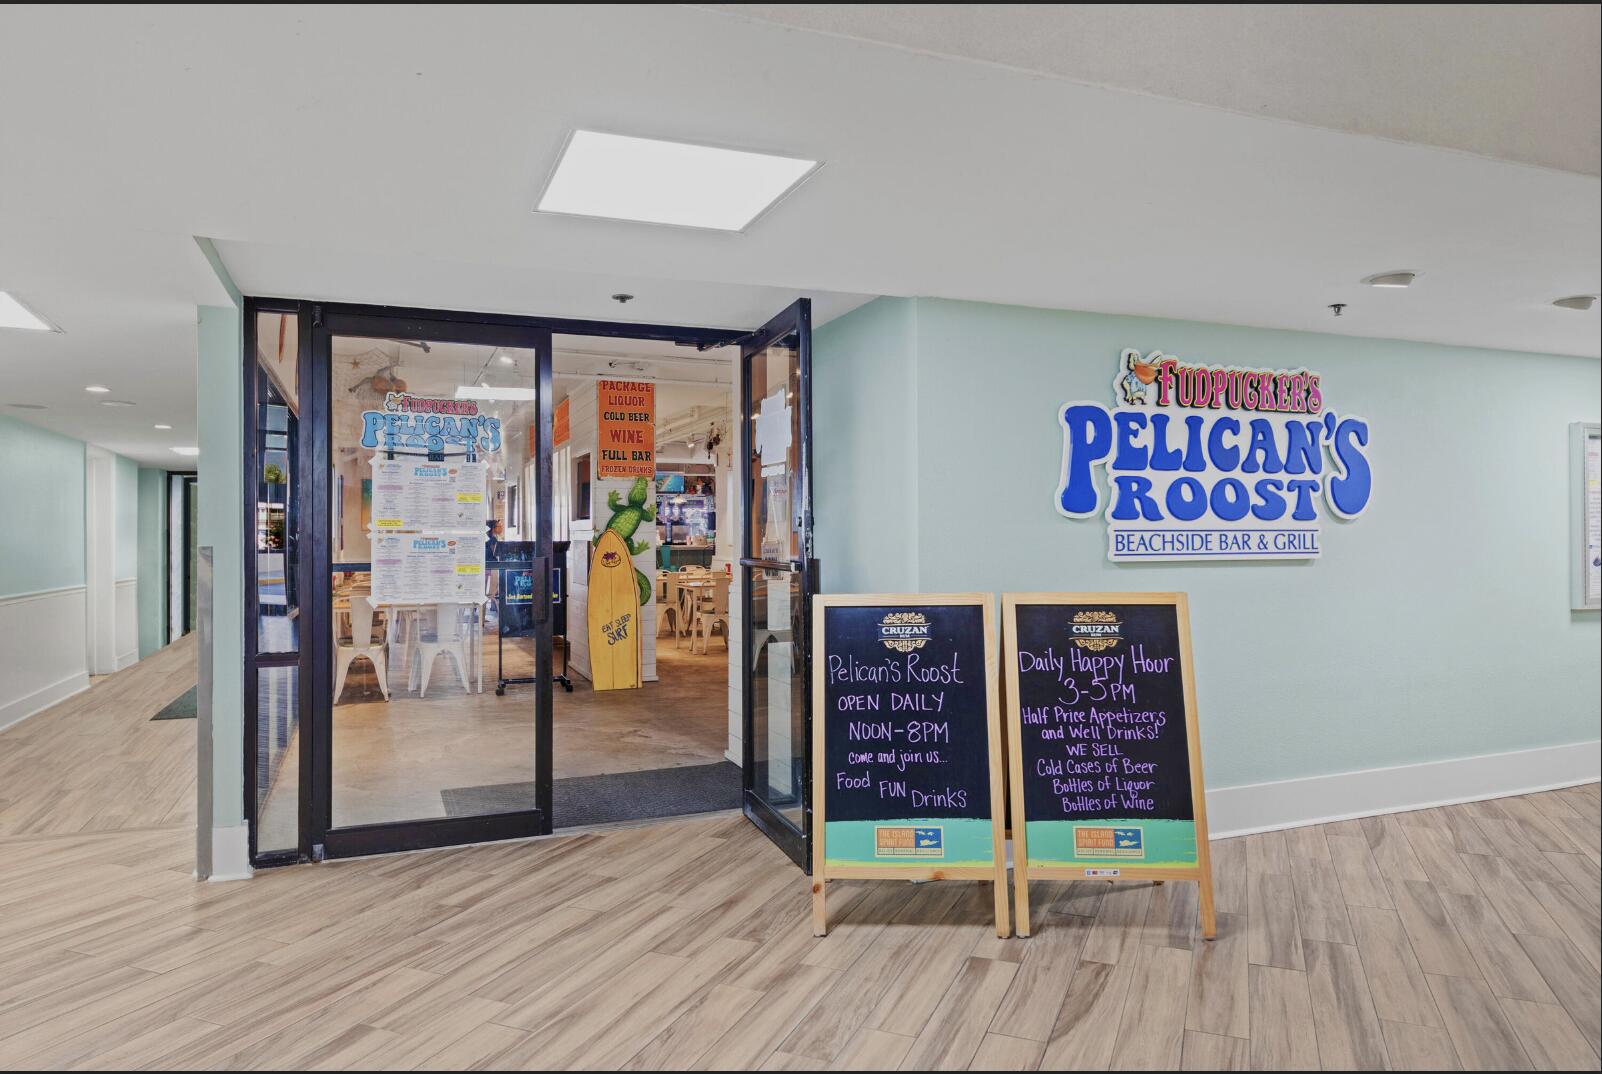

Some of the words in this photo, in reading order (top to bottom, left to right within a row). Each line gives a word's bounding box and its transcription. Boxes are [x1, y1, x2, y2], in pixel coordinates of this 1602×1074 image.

[601, 380, 651, 393] PACKAGE
[1157, 359, 1322, 414] FUDPUCKER'S
[608, 395, 645, 407] LIQUOR
[603, 411, 625, 421] COLD
[628, 412, 650, 422] BEER
[361, 411, 502, 452] PELICAN'S
[610, 429, 644, 444] WINE
[602, 449, 627, 461] FULL
[631, 450, 651, 461] BAR
[1060, 405, 1372, 515] PELICAN'S
[601, 465, 627, 473] FROZEN
[628, 466, 652, 474] DRINKS
[1111, 475, 1320, 522] ROOST
[1115, 533, 1213, 552] BEACHSIDE
[1219, 533, 1251, 551] BAR
[1257, 533, 1269, 550] &
[1273, 533, 1319, 550] GRILL
[607, 624, 629, 646] SURF
[881, 626, 928, 635] CRUZAN
[1072, 625, 1120, 634] CRUZAN
[828, 654, 901, 685] Pelican's
[907, 651, 965, 684] Roost
[1018, 647, 1064, 682] Daily
[1070, 647, 1125, 684] Happy
[1130, 643, 1175, 674] Hour
[838, 693, 880, 711] OPEN
[891, 691, 945, 712] DAILY
[1021, 706, 1050, 725] Half
[1054, 706, 1087, 723] Price
[1089, 706, 1166, 729] Appetizers
[1041, 724, 1065, 740] and
[1068, 723, 1100, 740] Well
[1107, 722, 1159, 740] Drinks!
[1065, 743, 1088, 757] WE
[1091, 742, 1125, 757] SELL
[877, 748, 896, 764] and
[896, 749, 923, 772] join
[925, 750, 948, 764] us...
[1036, 758, 1063, 777] Cold
[1066, 759, 1102, 775] Cases
[1105, 757, 1119, 774] of
[1122, 757, 1159, 775] Beer
[836, 770, 871, 790] Food
[879, 780, 907, 799] FUN
[911, 787, 967, 808] Drinks
[1052, 777, 1094, 795] Bottles
[1097, 775, 1112, 792] of
[1115, 776, 1156, 799] Liquor
[1062, 795, 1101, 812] Bottles
[1103, 793, 1119, 810] of
[1120, 793, 1155, 811] Wine
[1090, 830, 1113, 840] ISLAND
